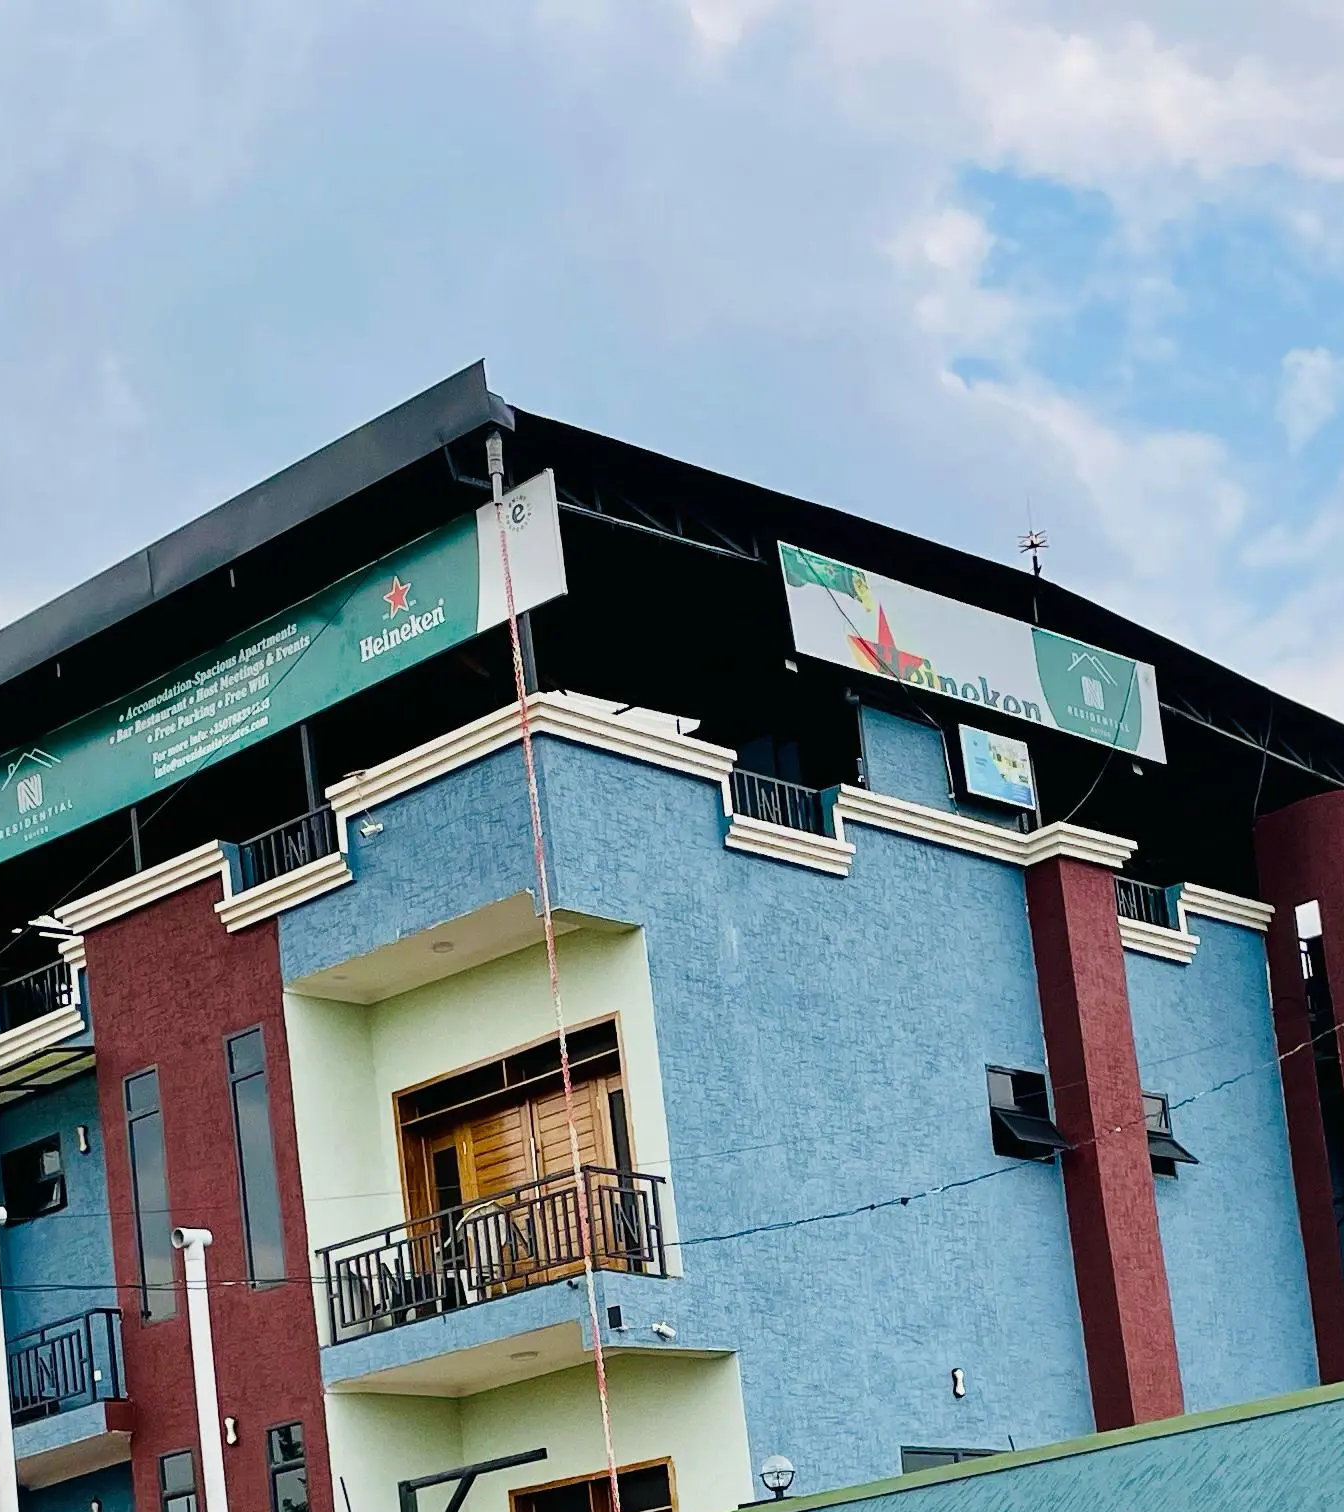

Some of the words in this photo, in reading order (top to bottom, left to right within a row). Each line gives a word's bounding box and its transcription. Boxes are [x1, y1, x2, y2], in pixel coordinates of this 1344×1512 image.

[238, 623, 297, 663] Apartments
[360, 605, 445, 662] Heineken
[116, 726, 134, 743] Bar
[135, 697, 189, 733] Restaurant
[196, 682, 219, 702] Host
[219, 660, 265, 692] Meetings
[266, 652, 274, 667] &
[275, 634, 311, 662] Events
[154, 724, 175, 741] Free
[177, 701, 216, 730] Parking
[224, 687, 248, 707] Free
[153, 749, 167, 765] For
[167, 740, 189, 758] more
